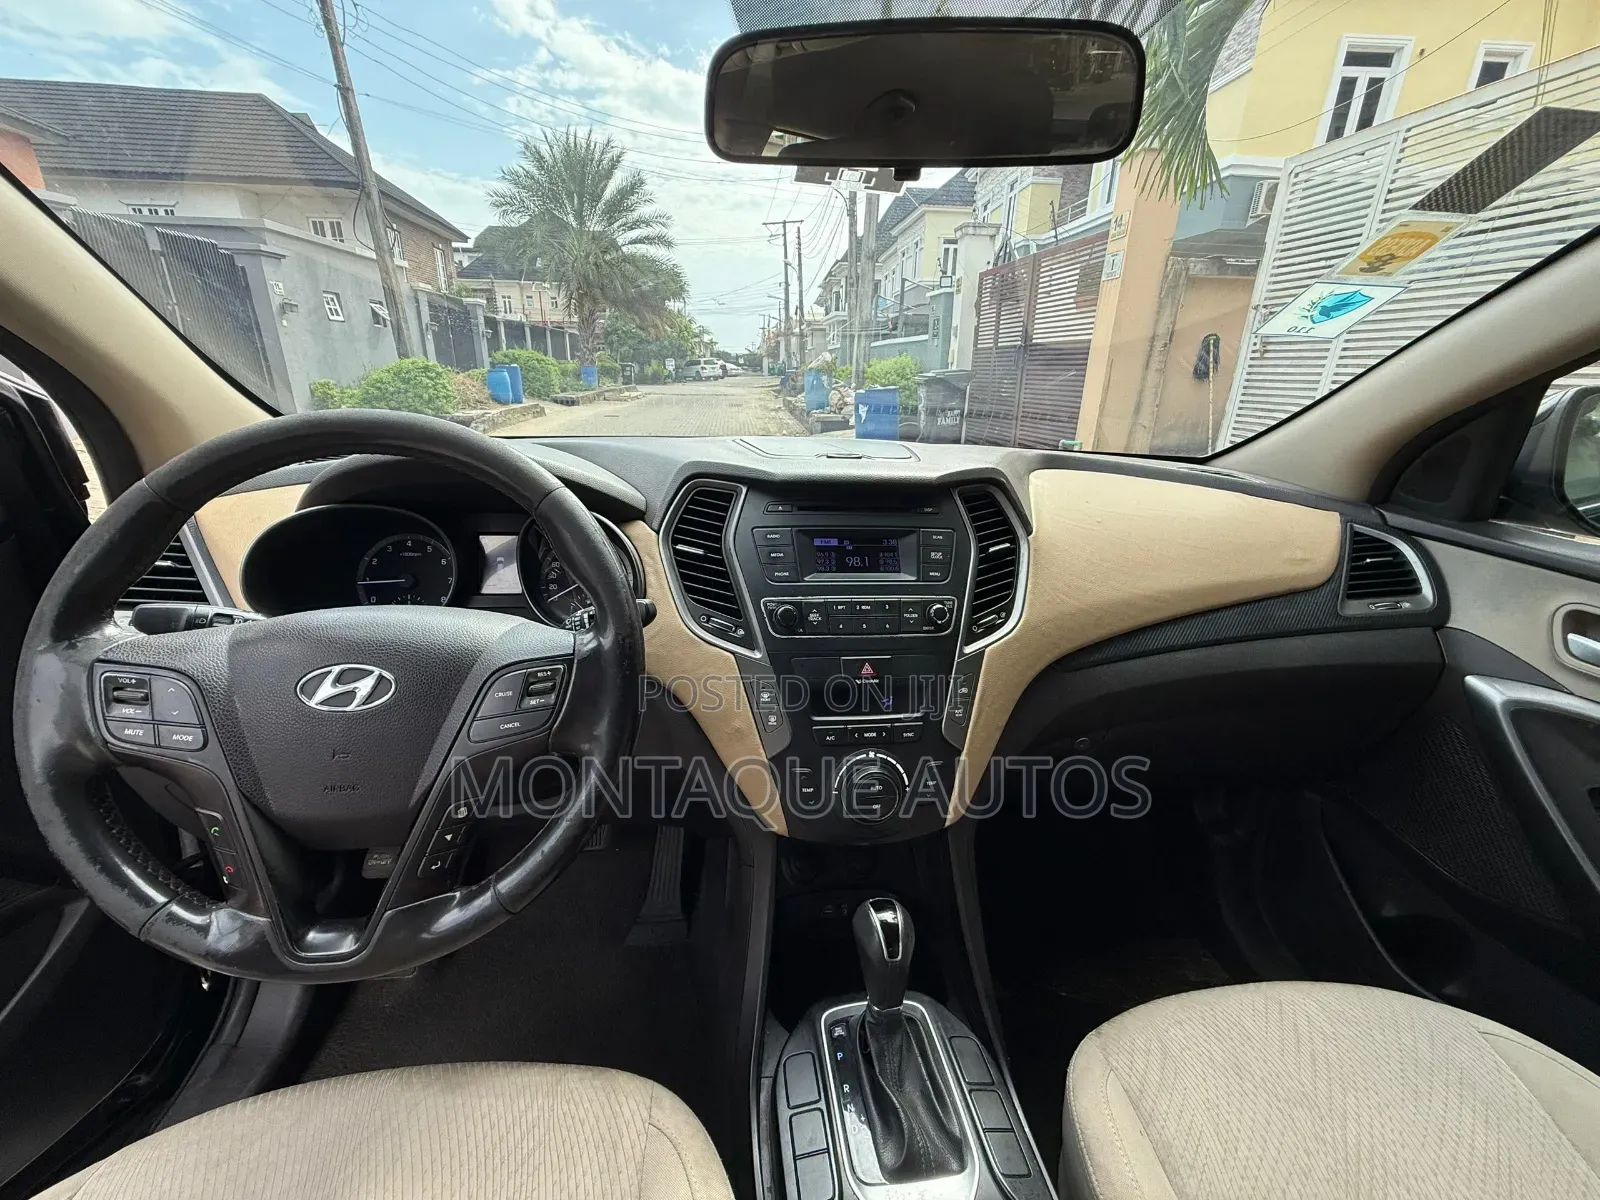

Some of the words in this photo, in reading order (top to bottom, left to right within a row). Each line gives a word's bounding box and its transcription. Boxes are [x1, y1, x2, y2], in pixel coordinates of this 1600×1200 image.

[936, 416, 960, 425] FAMILY
[426, 545, 433, 553] 5
[845, 556, 869, 567] 98.1
[494, 690, 513, 698] CRUISE
[499, 722, 521, 730] CANCEL
[123, 728, 145, 736] MUTE
[172, 733, 194, 742] MODE
[825, 734, 836, 742] A/C
[323, 783, 361, 794] AIRBAG
[836, 1052, 843, 1061] P
[843, 1084, 850, 1093] R
[846, 1104, 855, 1113] N
[851, 1125, 858, 1134] D
